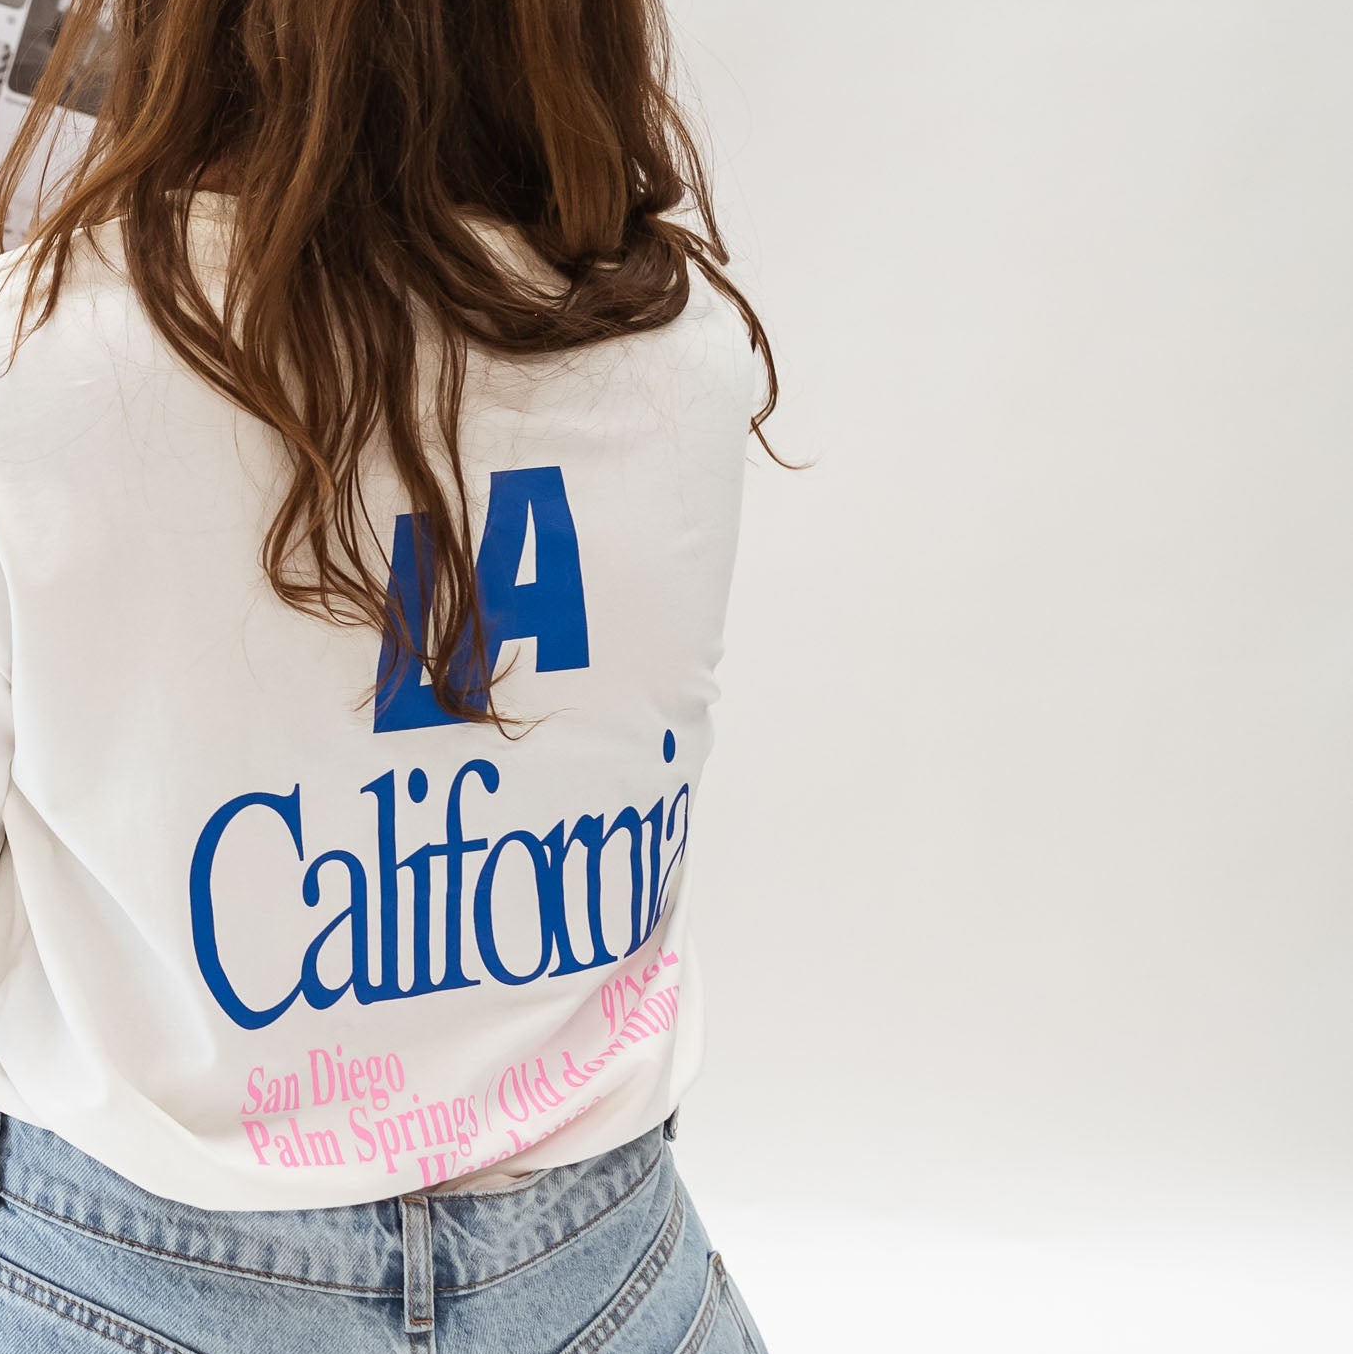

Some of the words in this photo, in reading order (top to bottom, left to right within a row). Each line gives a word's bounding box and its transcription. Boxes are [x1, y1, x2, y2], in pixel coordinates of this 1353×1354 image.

[373, 465, 589, 733] LA
[189, 728, 690, 1031] California
[241, 1067, 301, 1118] San
[310, 1046, 406, 1113] Diego
[244, 1120, 347, 1167] Palm
[354, 1093, 480, 1175] Springs
